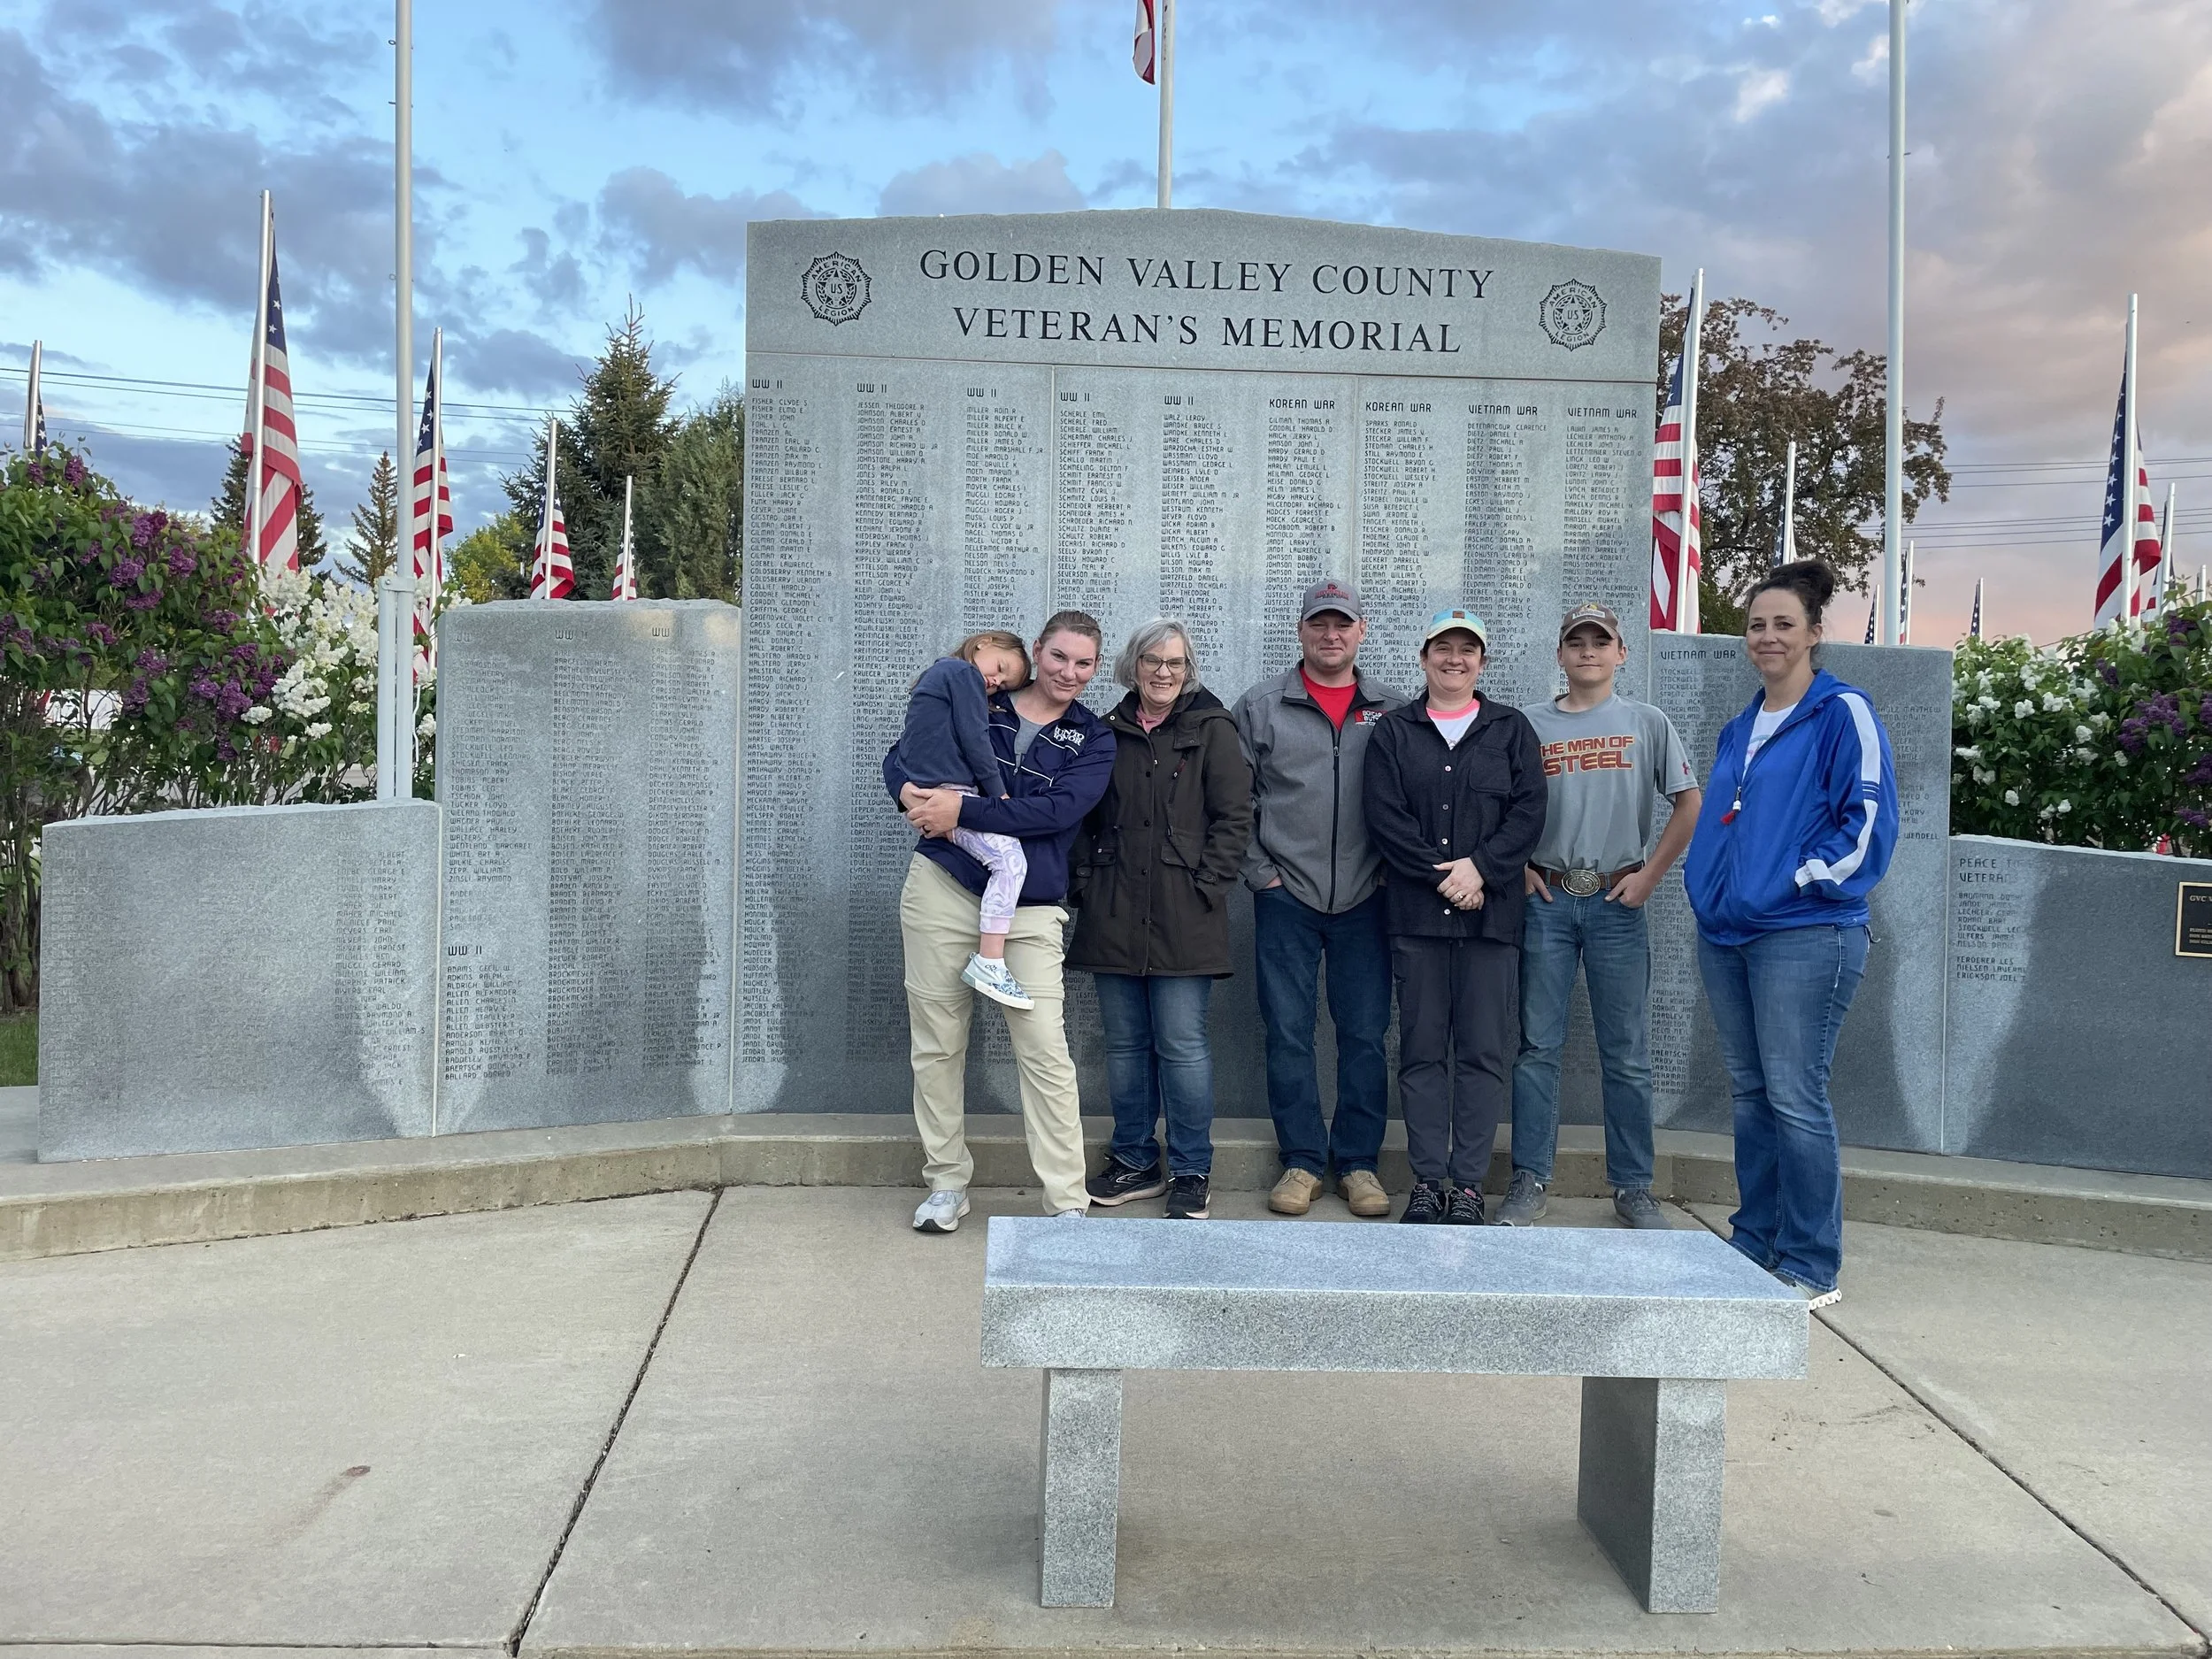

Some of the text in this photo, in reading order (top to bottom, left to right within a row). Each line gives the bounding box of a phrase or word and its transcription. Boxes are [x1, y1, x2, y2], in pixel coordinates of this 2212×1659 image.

[811, 261, 862, 282] AMERICAN
[920, 250, 1494, 299] GOLDEN VALLEY COUNTY
[831, 284, 842, 294] US
[1549, 287, 1597, 308] AMERICAN
[818, 305, 854, 316] LEGION
[1567, 310, 1579, 320] US
[953, 308, 1461, 353] VETERAN'S MEMORIAL
[1555, 331, 1590, 342] LEGION
[753, 379, 769, 389] WW
[857, 383, 875, 393] WW
[967, 388, 984, 398] WW
[1060, 392, 1077, 402] WW
[1164, 396, 1181, 405] WW
[1268, 398, 1335, 410] KOREAN WAR
[1365, 401, 1431, 413] KOREAN WAR
[1468, 404, 1537, 416] VIETNAM WAR
[1567, 407, 1637, 419] VIETNAM WAR
[555, 630, 574, 640] WW
[652, 628, 670, 637] WW
[1660, 650, 1736, 660] VIETNAM WAR
[1540, 735, 1634, 757] HE MAN OF
[1543, 750, 1633, 777] STEEL
[1960, 858, 1997, 868] PEACE
[448, 945, 468, 956] WW
